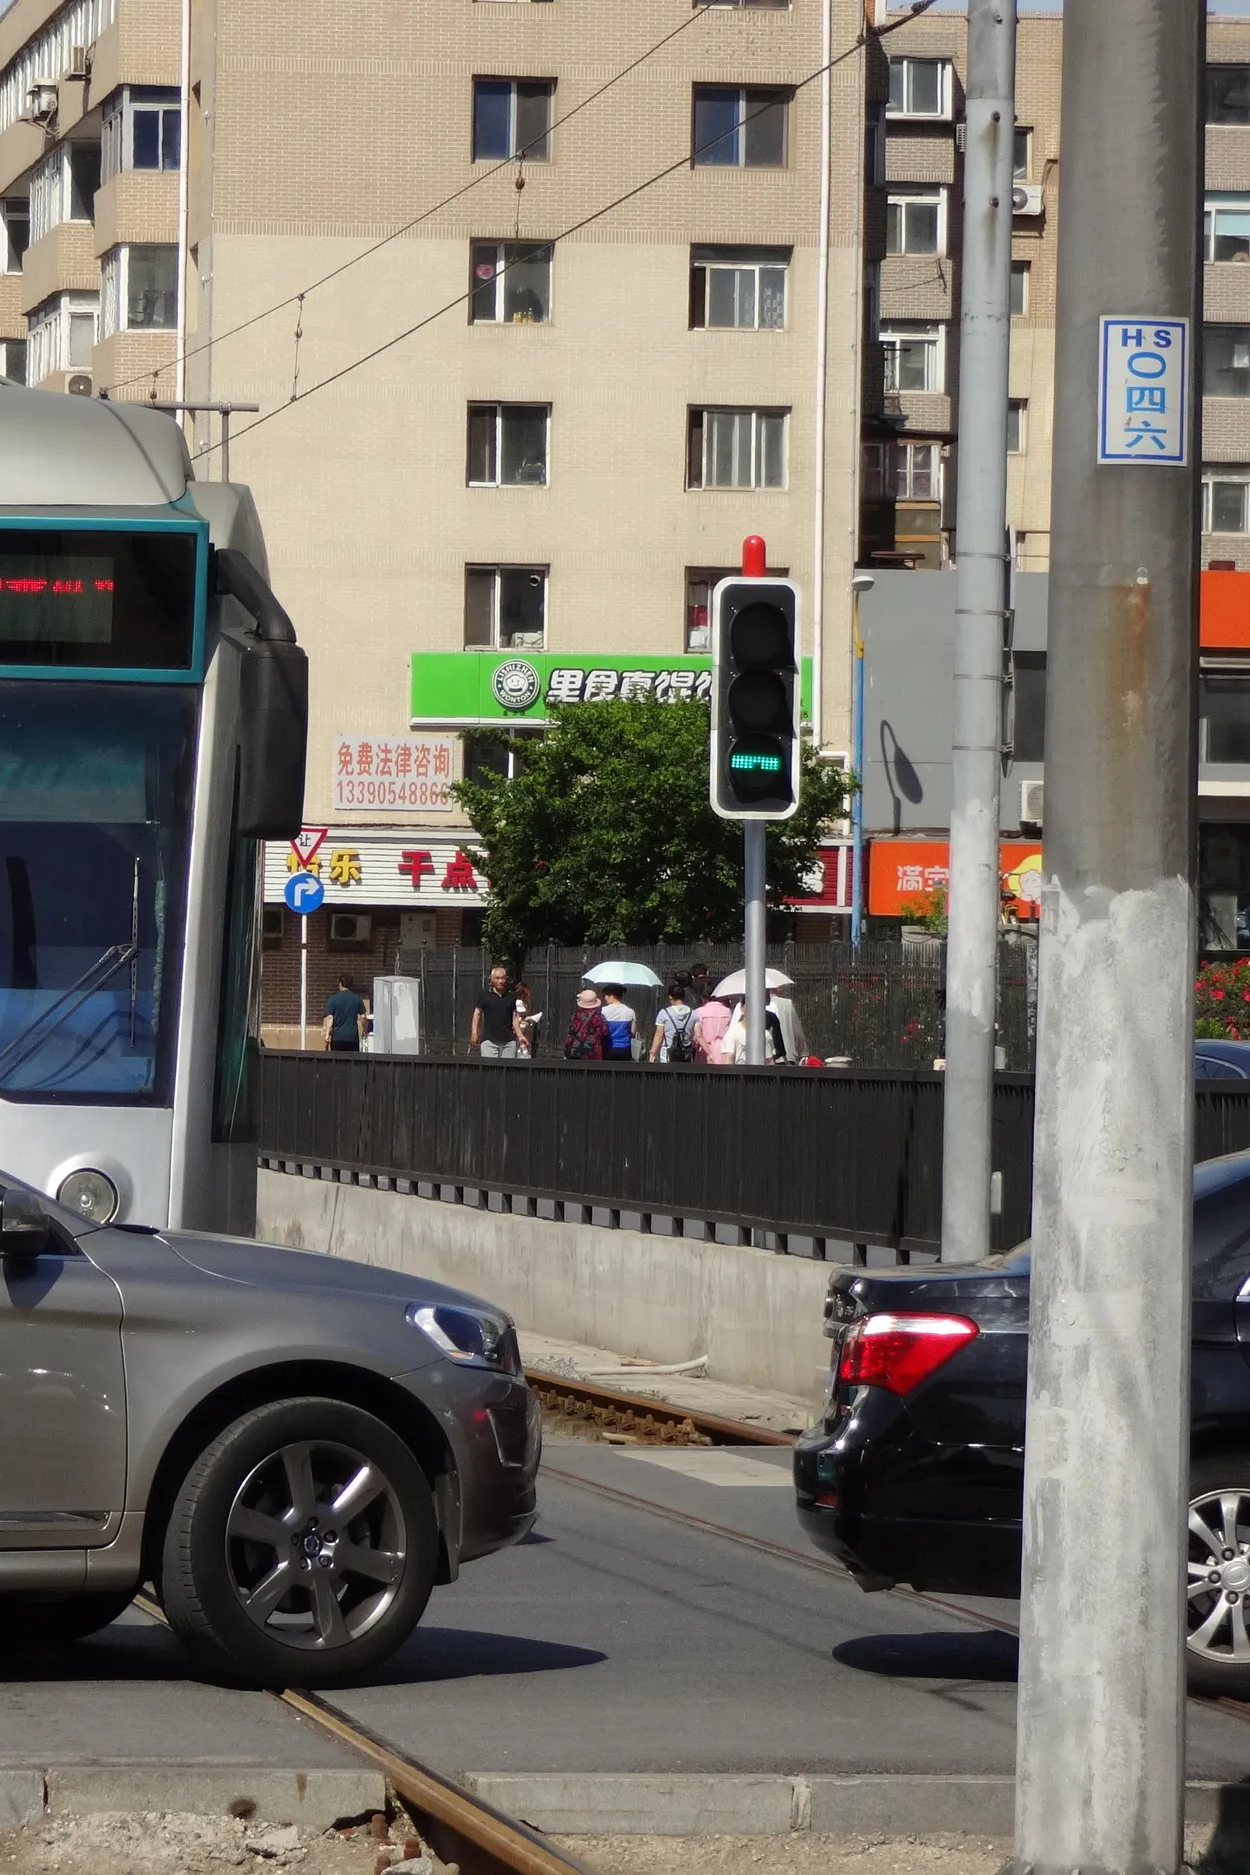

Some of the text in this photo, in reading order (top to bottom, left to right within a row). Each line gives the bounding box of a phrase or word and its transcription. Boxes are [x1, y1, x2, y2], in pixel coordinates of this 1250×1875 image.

[1121, 328, 1172, 348] HS
[497, 664, 535, 682] LISHIZHEN
[500, 689, 531, 703] WONTON
[547, 669, 712, 704] 里食真馄
[337, 742, 450, 779] 免费法律咨询
[298, 834, 311, 847] 让
